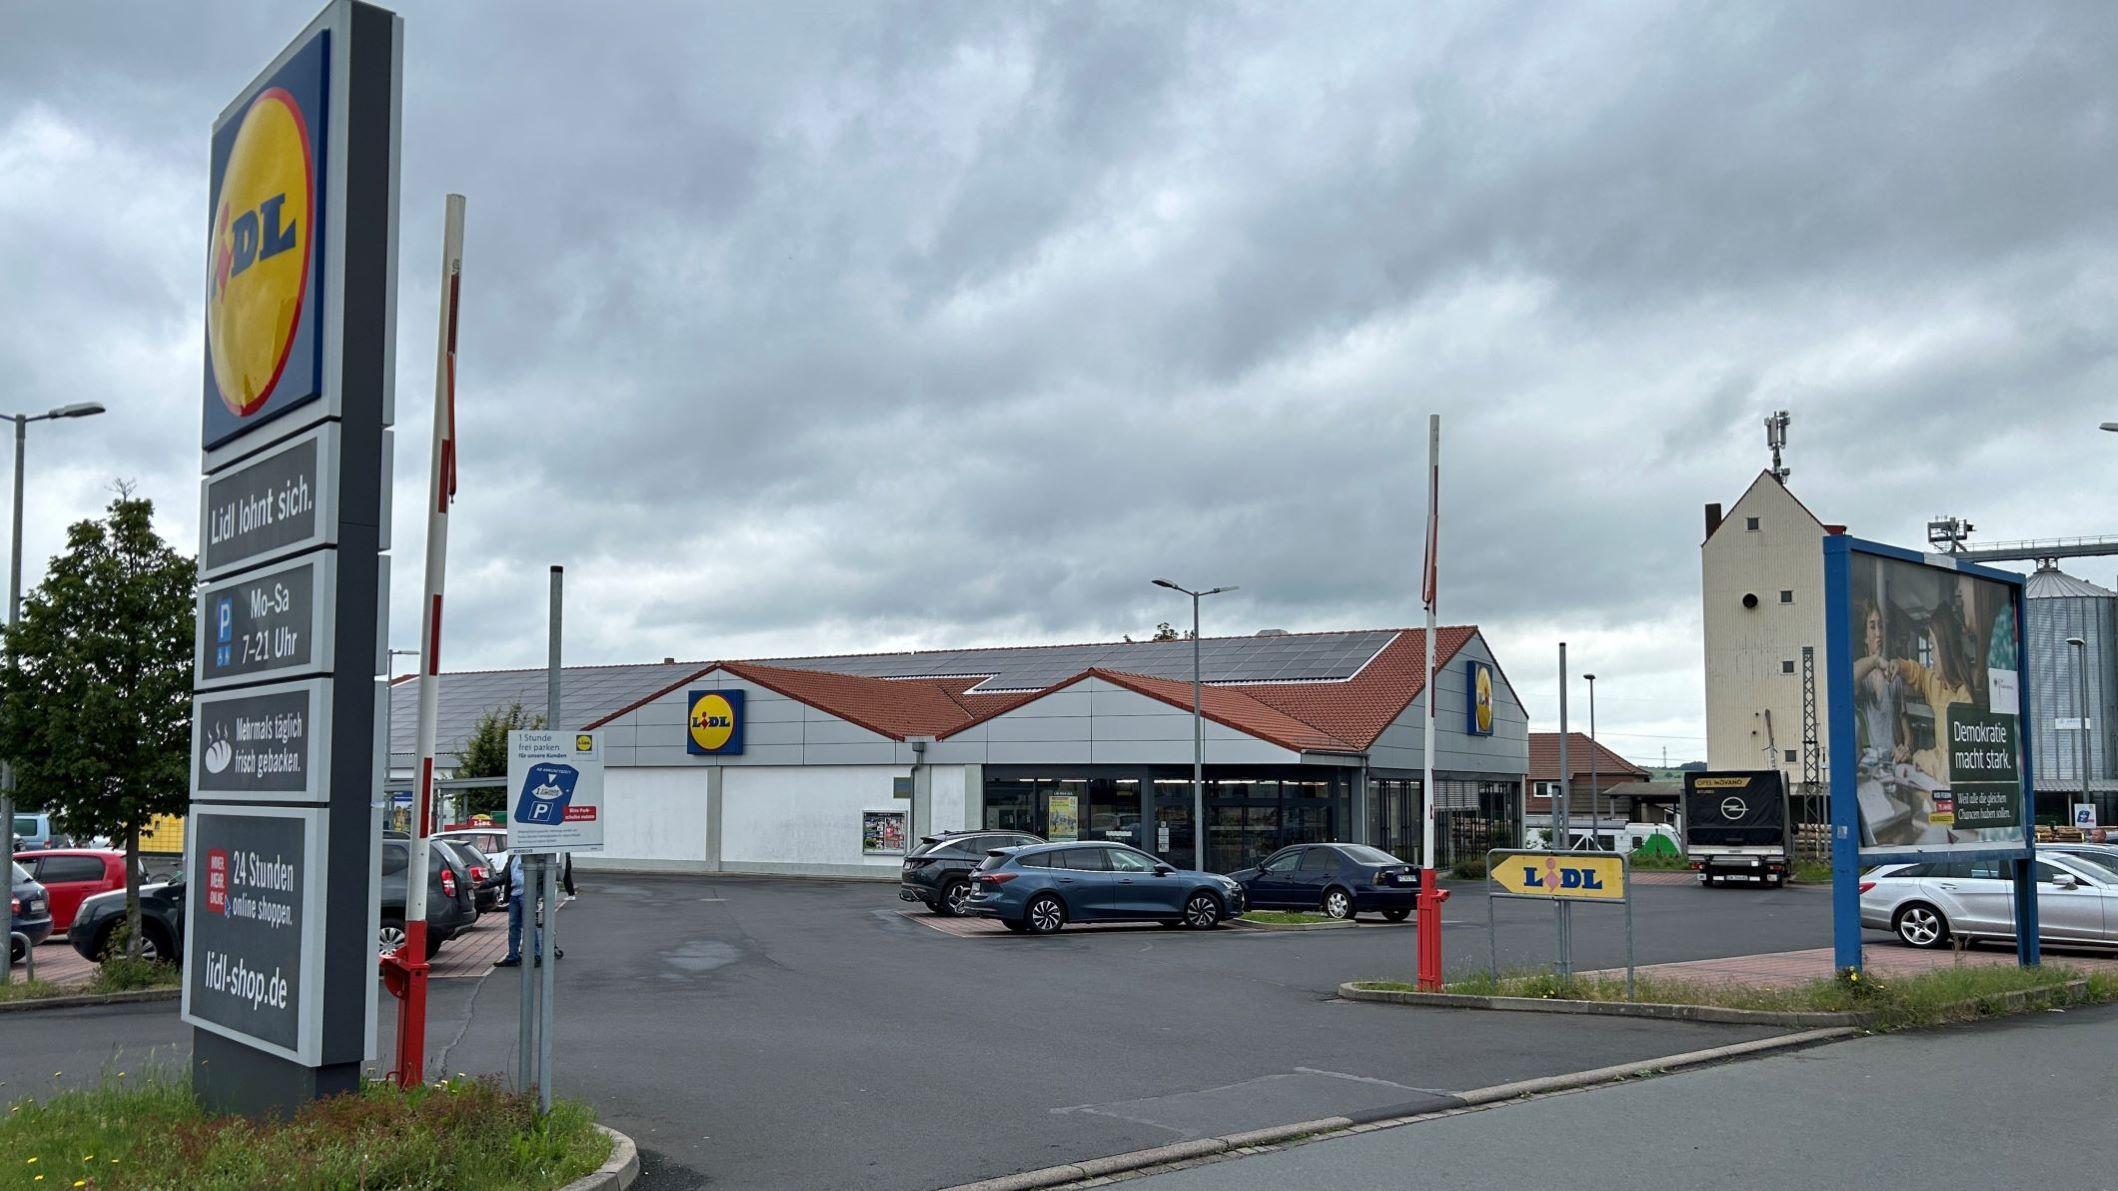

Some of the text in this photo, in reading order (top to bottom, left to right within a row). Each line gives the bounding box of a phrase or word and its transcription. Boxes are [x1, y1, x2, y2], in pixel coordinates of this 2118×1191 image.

[211, 474, 312, 544] Lidl lohnt sich.
[250, 583, 289, 619] Mo-Sa
[242, 626, 297, 664] 7-21 Uhr
[236, 712, 302, 744] Mehrmals täglich
[524, 734, 552, 742] Stunde
[1953, 721, 2007, 743] Demokratie
[235, 747, 301, 778] frisch gebacken.
[518, 743, 560, 752] frei parken
[1955, 748, 2012, 769] macht stark.
[533, 804, 548, 819] P
[1957, 792, 1969, 804] Weil
[1987, 792, 2007, 806] gleichen
[1958, 808, 1980, 820] Chancen
[1980, 807, 1996, 819] haben
[233, 850, 294, 892] 24 Stunden
[232, 892, 293, 929] online shoppen.
[205, 951, 288, 1010] lidl-shop.de
